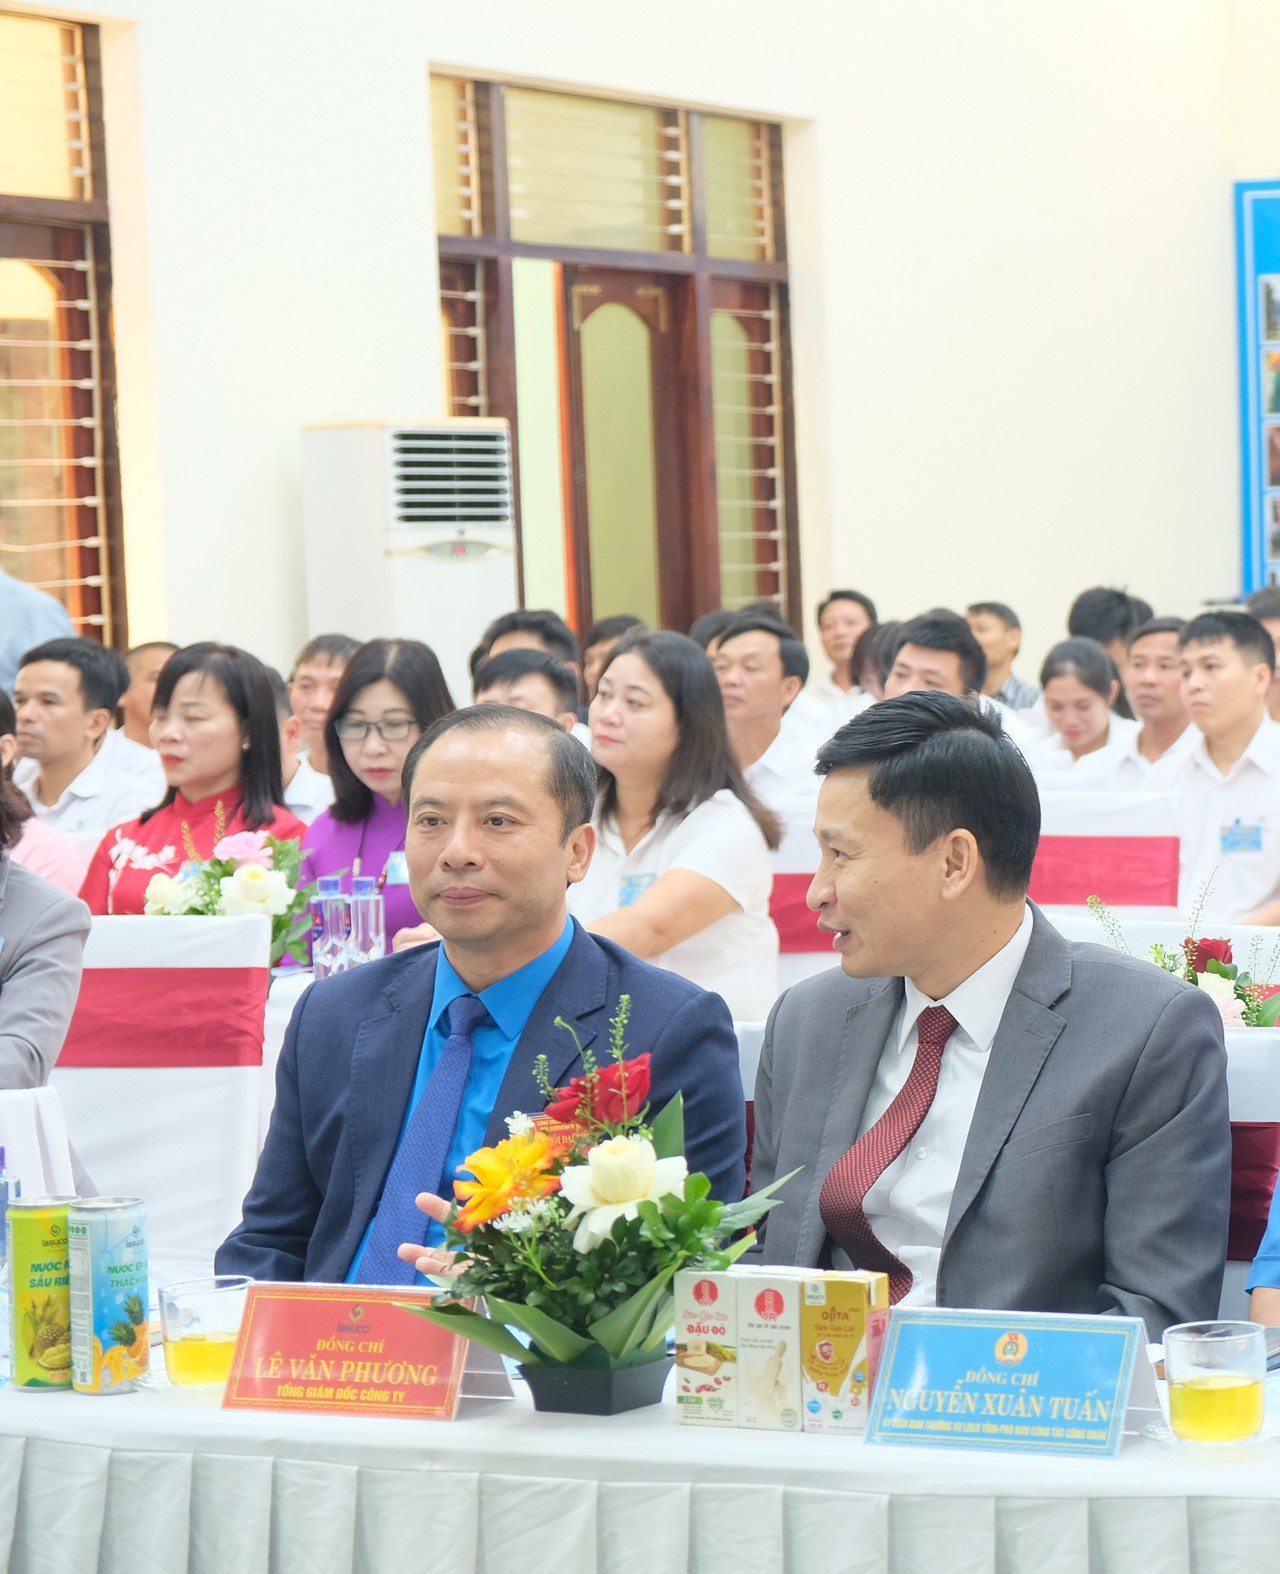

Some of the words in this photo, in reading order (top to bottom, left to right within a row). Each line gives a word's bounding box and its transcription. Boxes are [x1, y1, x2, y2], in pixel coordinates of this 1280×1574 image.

[337, 1322, 370, 1334] lasuco
[686, 1322, 709, 1336] ĐẬU
[711, 1322, 726, 1336] ĐỎ
[316, 1334, 354, 1352] ĐỒNG
[358, 1339, 385, 1354] CHÍ
[254, 1351, 283, 1379] LÊ
[289, 1352, 334, 1382] VĂN
[338, 1360, 438, 1387] PHƯƠNG
[966, 1366, 1007, 1386] ĐỒNG
[1010, 1371, 1040, 1387] CHÍ
[276, 1381, 303, 1398] TỔNG
[306, 1384, 333, 1399] GIÁM
[336, 1384, 358, 1400] ĐỐC
[360, 1386, 389, 1402] CÔNG
[392, 1391, 405, 1403] TY
[886, 1378, 979, 1414] NGUYỄN
[980, 1388, 1045, 1418] XUÂN
[1049, 1389, 1112, 1422] TUẤN
